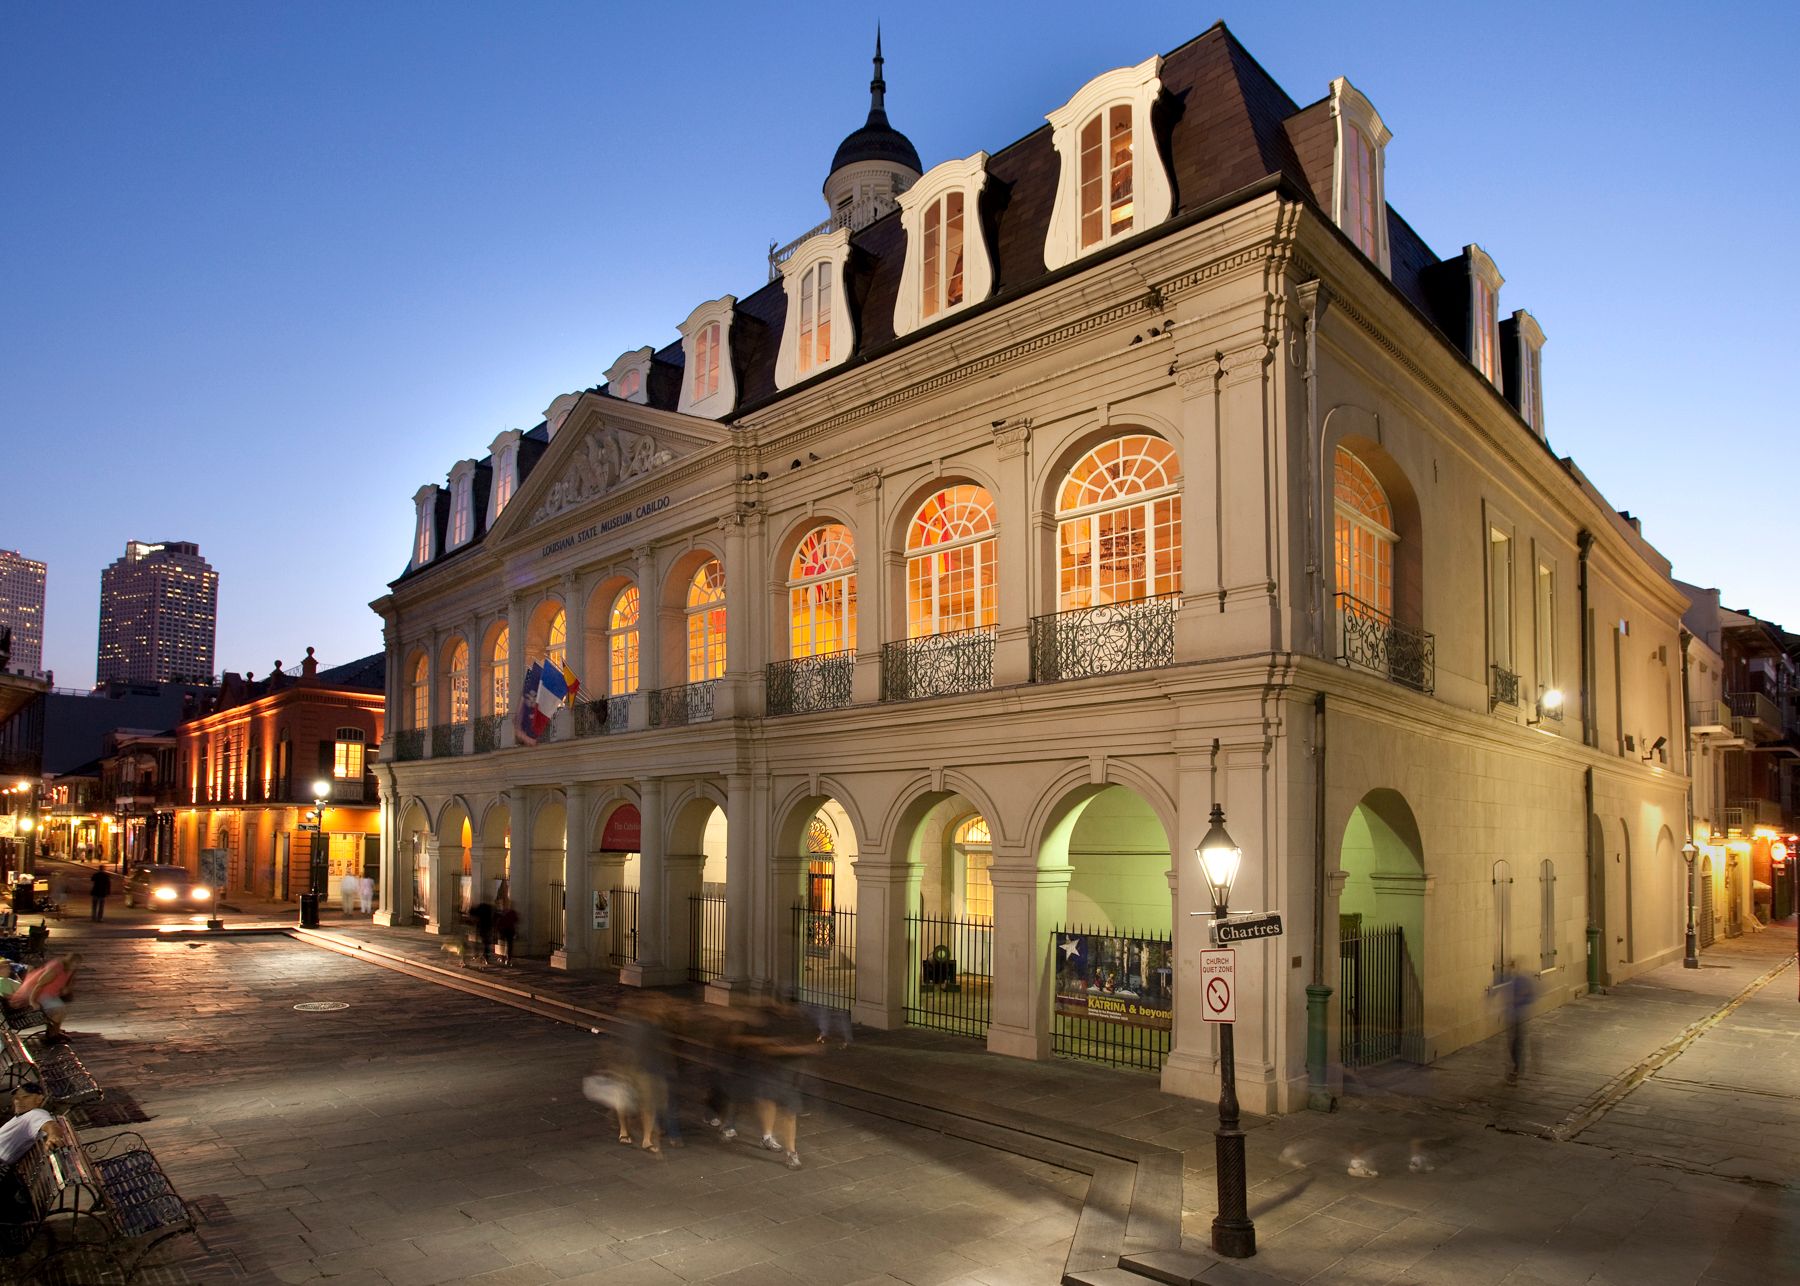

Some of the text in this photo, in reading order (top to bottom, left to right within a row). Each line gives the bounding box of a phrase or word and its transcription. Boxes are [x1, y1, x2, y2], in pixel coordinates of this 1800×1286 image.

[542, 496, 670, 557] LOUISIANA STATE MUSEUM CABILDO
[1220, 924, 1280, 940] Chartres
[1206, 957, 1230, 965] CHURCH
[1088, 998, 1126, 1013] KATRINA
[1129, 1004, 1137, 1014] &
